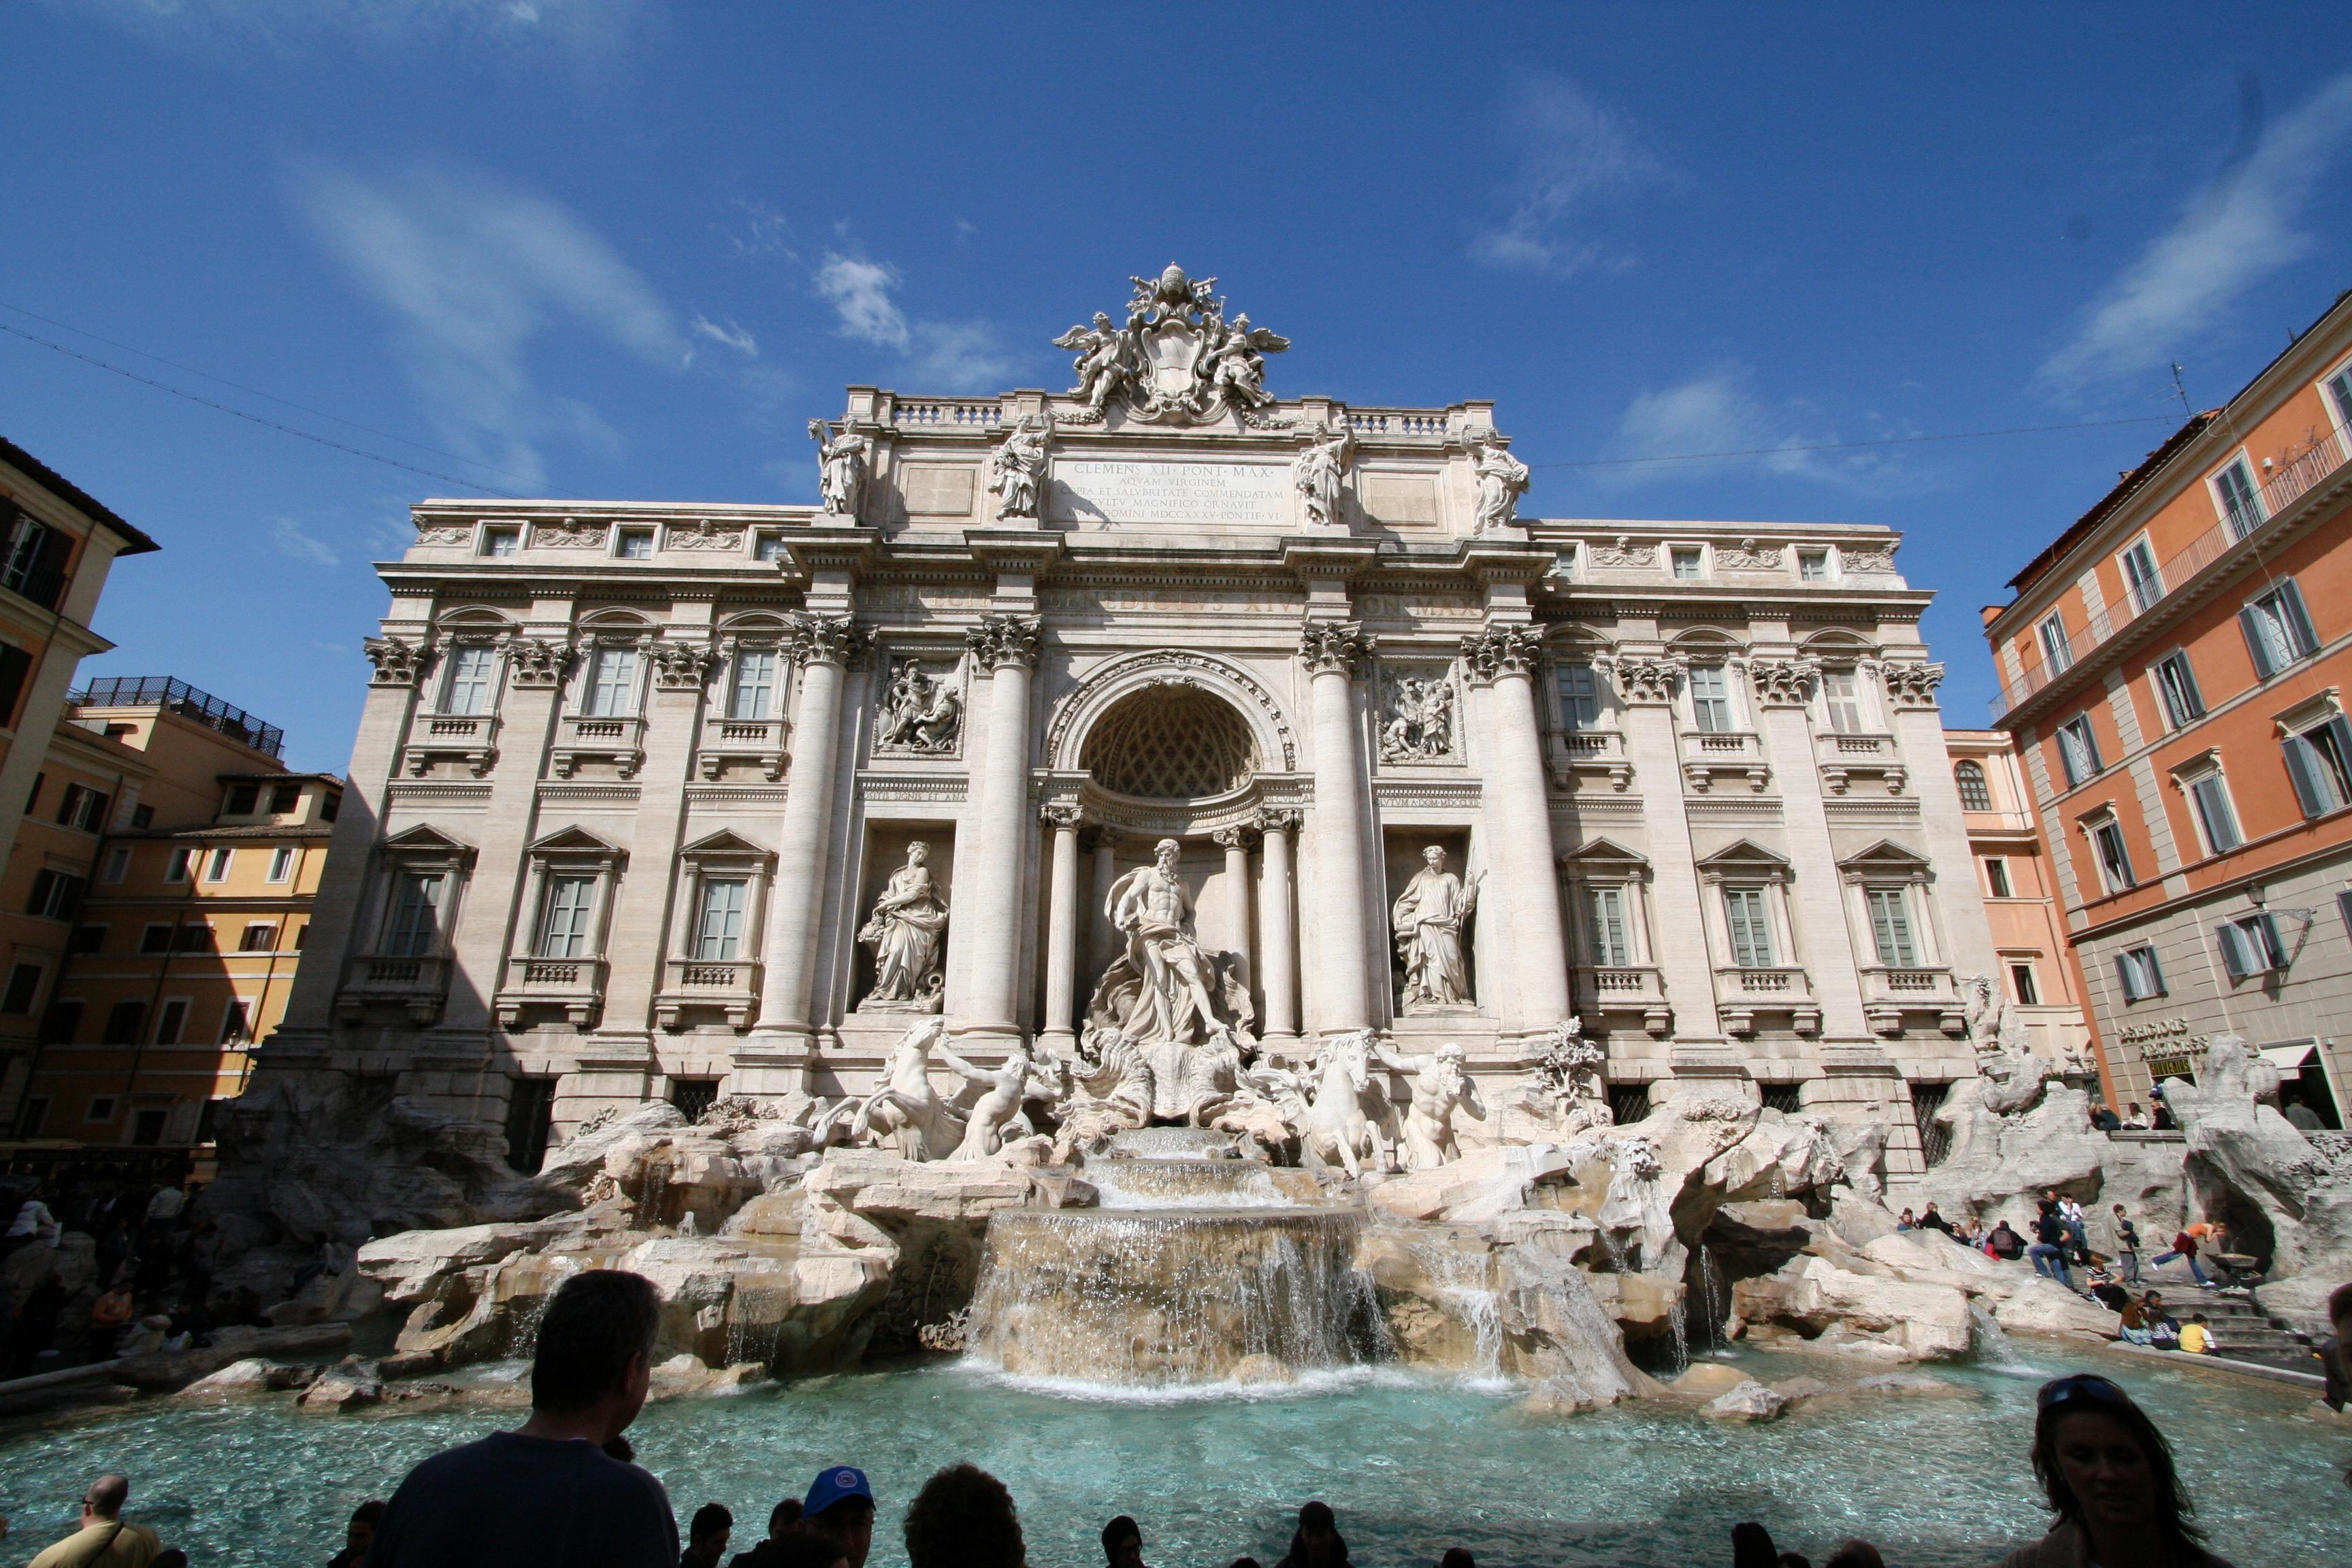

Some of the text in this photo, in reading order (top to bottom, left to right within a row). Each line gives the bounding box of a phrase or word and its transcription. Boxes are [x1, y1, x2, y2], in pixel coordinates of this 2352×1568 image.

[1074, 463, 1141, 475] CLEMENS
[1119, 477, 1226, 487] AQVAM VIRGINEM
[1060, 486, 1284, 500] COPIA ET SALVBRITATE COMMENDATAM
[1090, 498, 1256, 509] CVLTV MAGNIFICO ORNAVIT
[1063, 508, 1098, 517] ANNO
[1103, 509, 1145, 518] DOMINI
[1047, 589, 1224, 611] BENEDICTVS
[858, 791, 890, 800] POSITIS
[894, 792, 921, 801] SIGNIS
[928, 793, 938, 801] ET
[2149, 1058, 2190, 1076] SOUVENIRS
